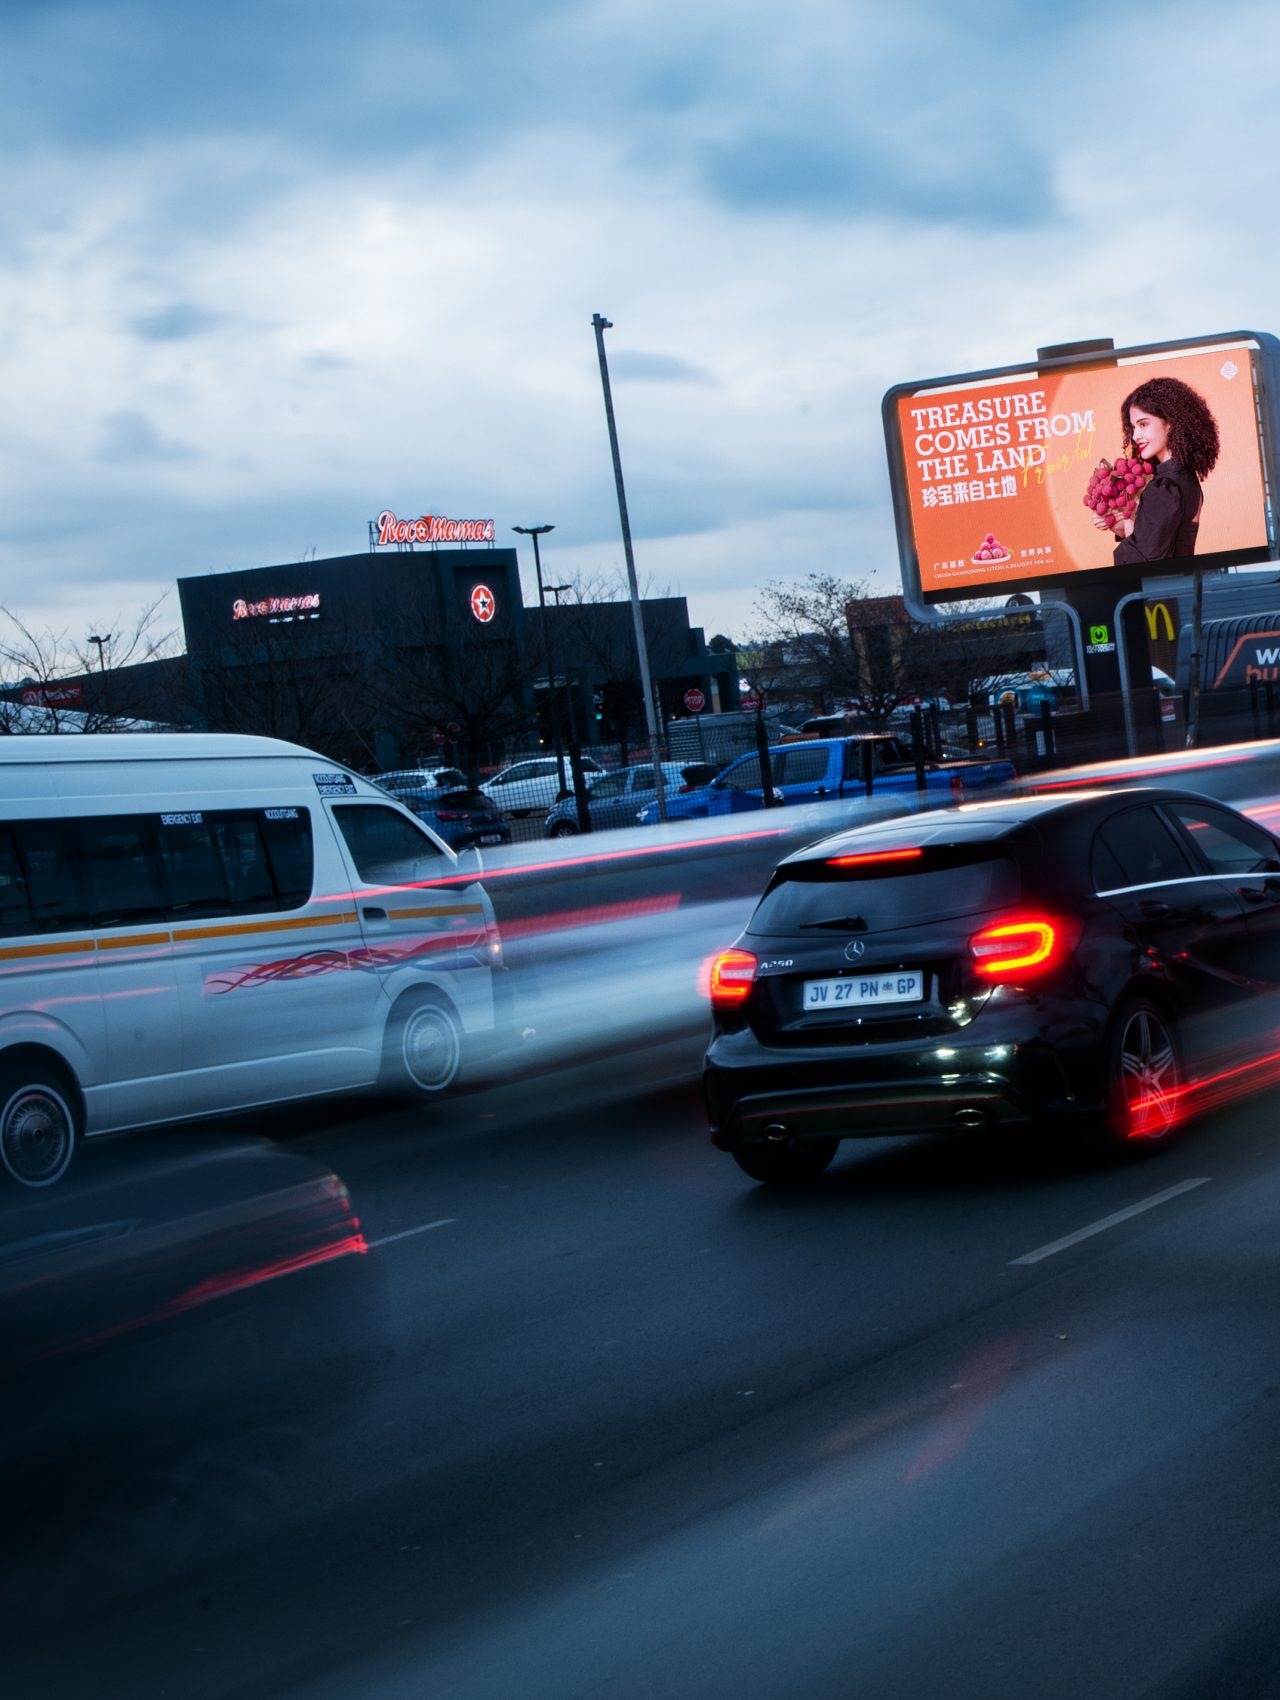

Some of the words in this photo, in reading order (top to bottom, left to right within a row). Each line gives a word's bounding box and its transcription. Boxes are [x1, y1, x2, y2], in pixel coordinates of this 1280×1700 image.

[911, 391, 1046, 431] TREASURE
[915, 422, 1011, 456] COMES
[1017, 410, 1095, 442] FROM
[918, 454, 969, 481] THE
[974, 444, 1046, 473] LAND
[922, 475, 1018, 508] 珍宝来自土地
[1010, 561, 1033, 569] DELIGHT
[687, 695, 702, 705] STOP
[346, 784, 357, 794] EXIT
[160, 814, 191, 825] EMERGENCY
[192, 813, 202, 824] EXIT
[810, 985, 828, 1003] JV
[835, 983, 853, 1001] 27
[860, 981, 878, 998] PN
[897, 978, 916, 995] GP
